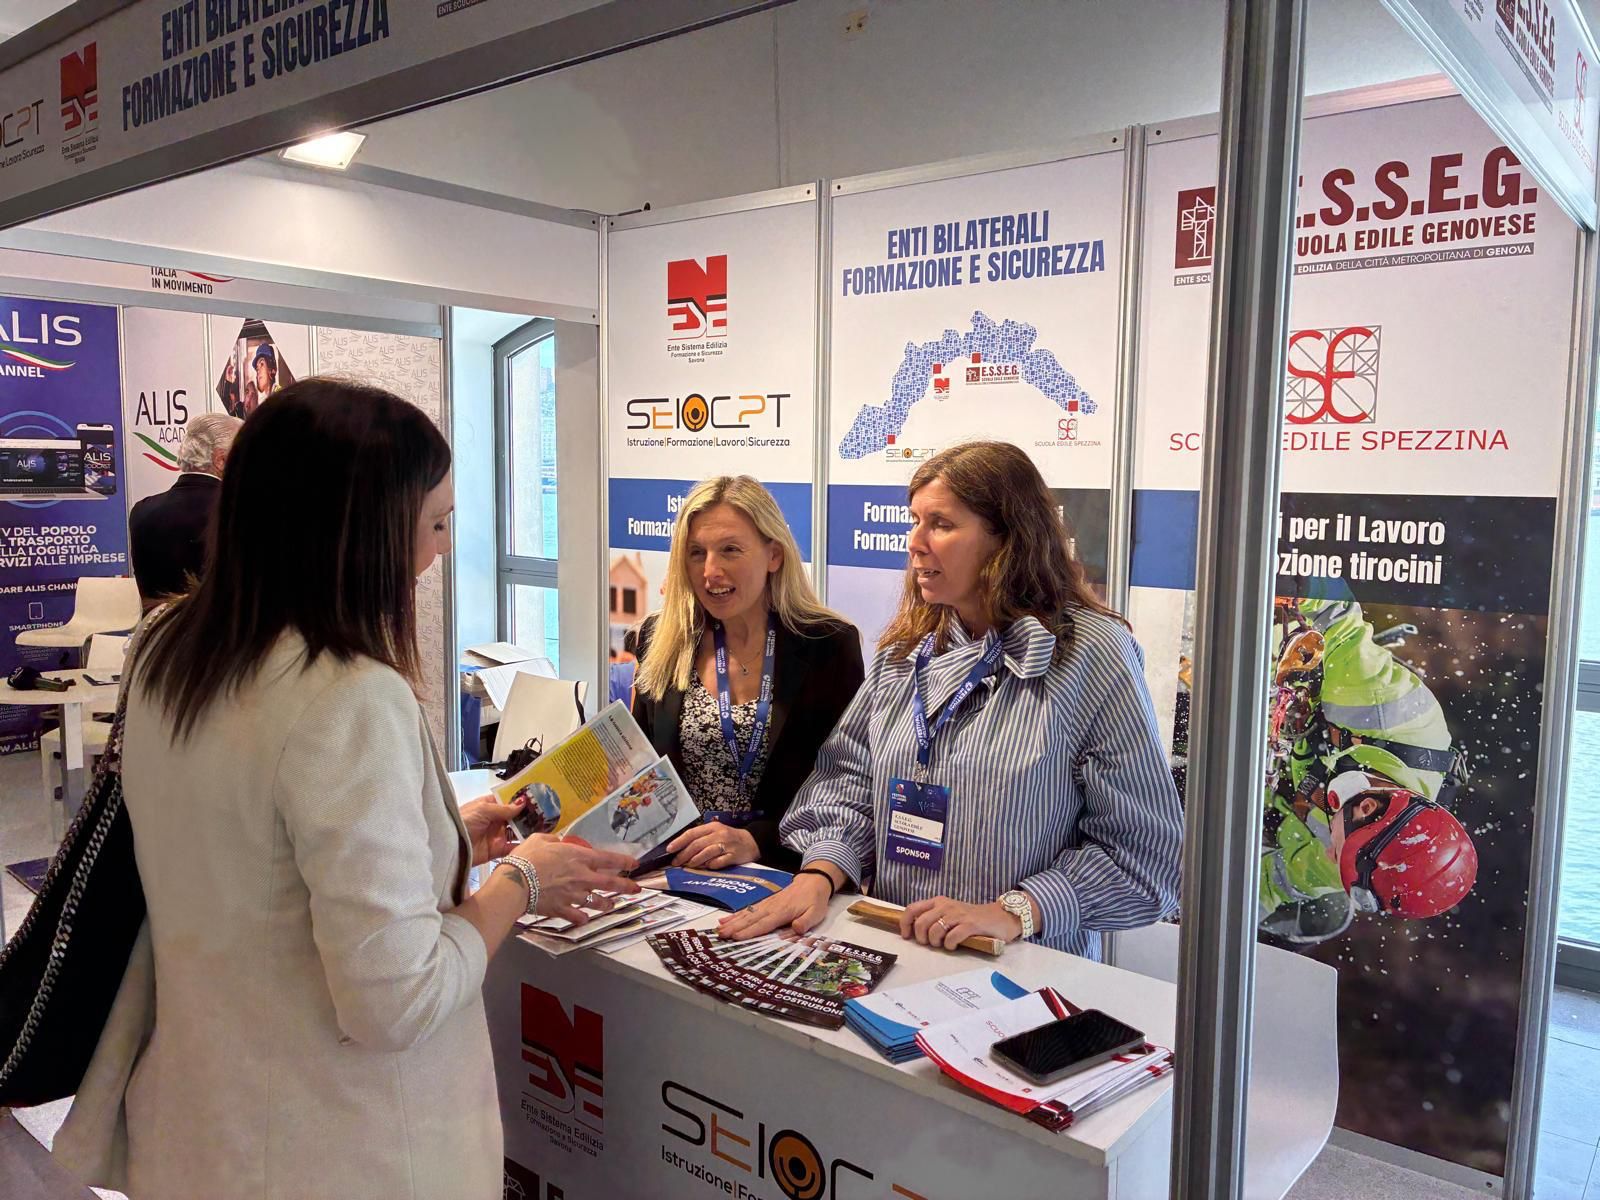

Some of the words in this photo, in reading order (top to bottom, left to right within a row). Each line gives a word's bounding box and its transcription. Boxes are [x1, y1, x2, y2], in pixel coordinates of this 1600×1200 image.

[162, 0, 200, 60] ENTI
[122, 41, 237, 131] FORMAZIONE
[243, 34, 255, 87] E
[262, 0, 389, 79] SICUREZZA
[888, 226, 928, 259] ENTI
[933, 210, 1049, 254] BILATERALI
[1354, 225, 1414, 251] EDILE
[1422, 212, 1536, 245] GENOVESE
[843, 256, 963, 296] FORMAZIONE
[970, 254, 981, 284] E
[987, 240, 1105, 282] SICUREZZA
[1298, 263, 1333, 273] EDILIZIA
[1336, 260, 1363, 270] DELLA
[1391, 248, 1471, 266] METROPOLITANA
[1473, 249, 1484, 258] DI
[1486, 244, 1532, 256] GENOVA
[152, 278, 161, 288] IN
[163, 279, 213, 295] MOVIMENTO
[1176, 277, 1194, 285] ENTE
[667, 344, 681, 352] Ente
[681, 343, 705, 351] Sistema
[706, 340, 728, 350] Edilizia
[136, 390, 188, 426] ALIS
[1361, 429, 1509, 451] SPEZZINA
[84, 452, 111, 461] ALIS
[14, 527, 38, 536] DEL
[41, 525, 97, 536] POPOLO
[1289, 517, 1330, 543] per
[1336, 513, 1352, 541] il
[1358, 515, 1446, 546] Lavoro
[8, 535, 91, 547] TRASPORTO
[29, 545, 99, 556] LOGISTICA
[34, 554, 66, 566] ALLE
[69, 553, 126, 565] IMPRESE
[1350, 551, 1443, 586] tirocini
[25, 584, 46, 592] ALIS
[896, 846, 930, 860] SPONSOR
[780, 987, 826, 1005] PERSONE
[826, 1000, 839, 1008] IN
[541, 1110, 572, 1134] Sistema
[574, 1128, 604, 1151] Edilizia
